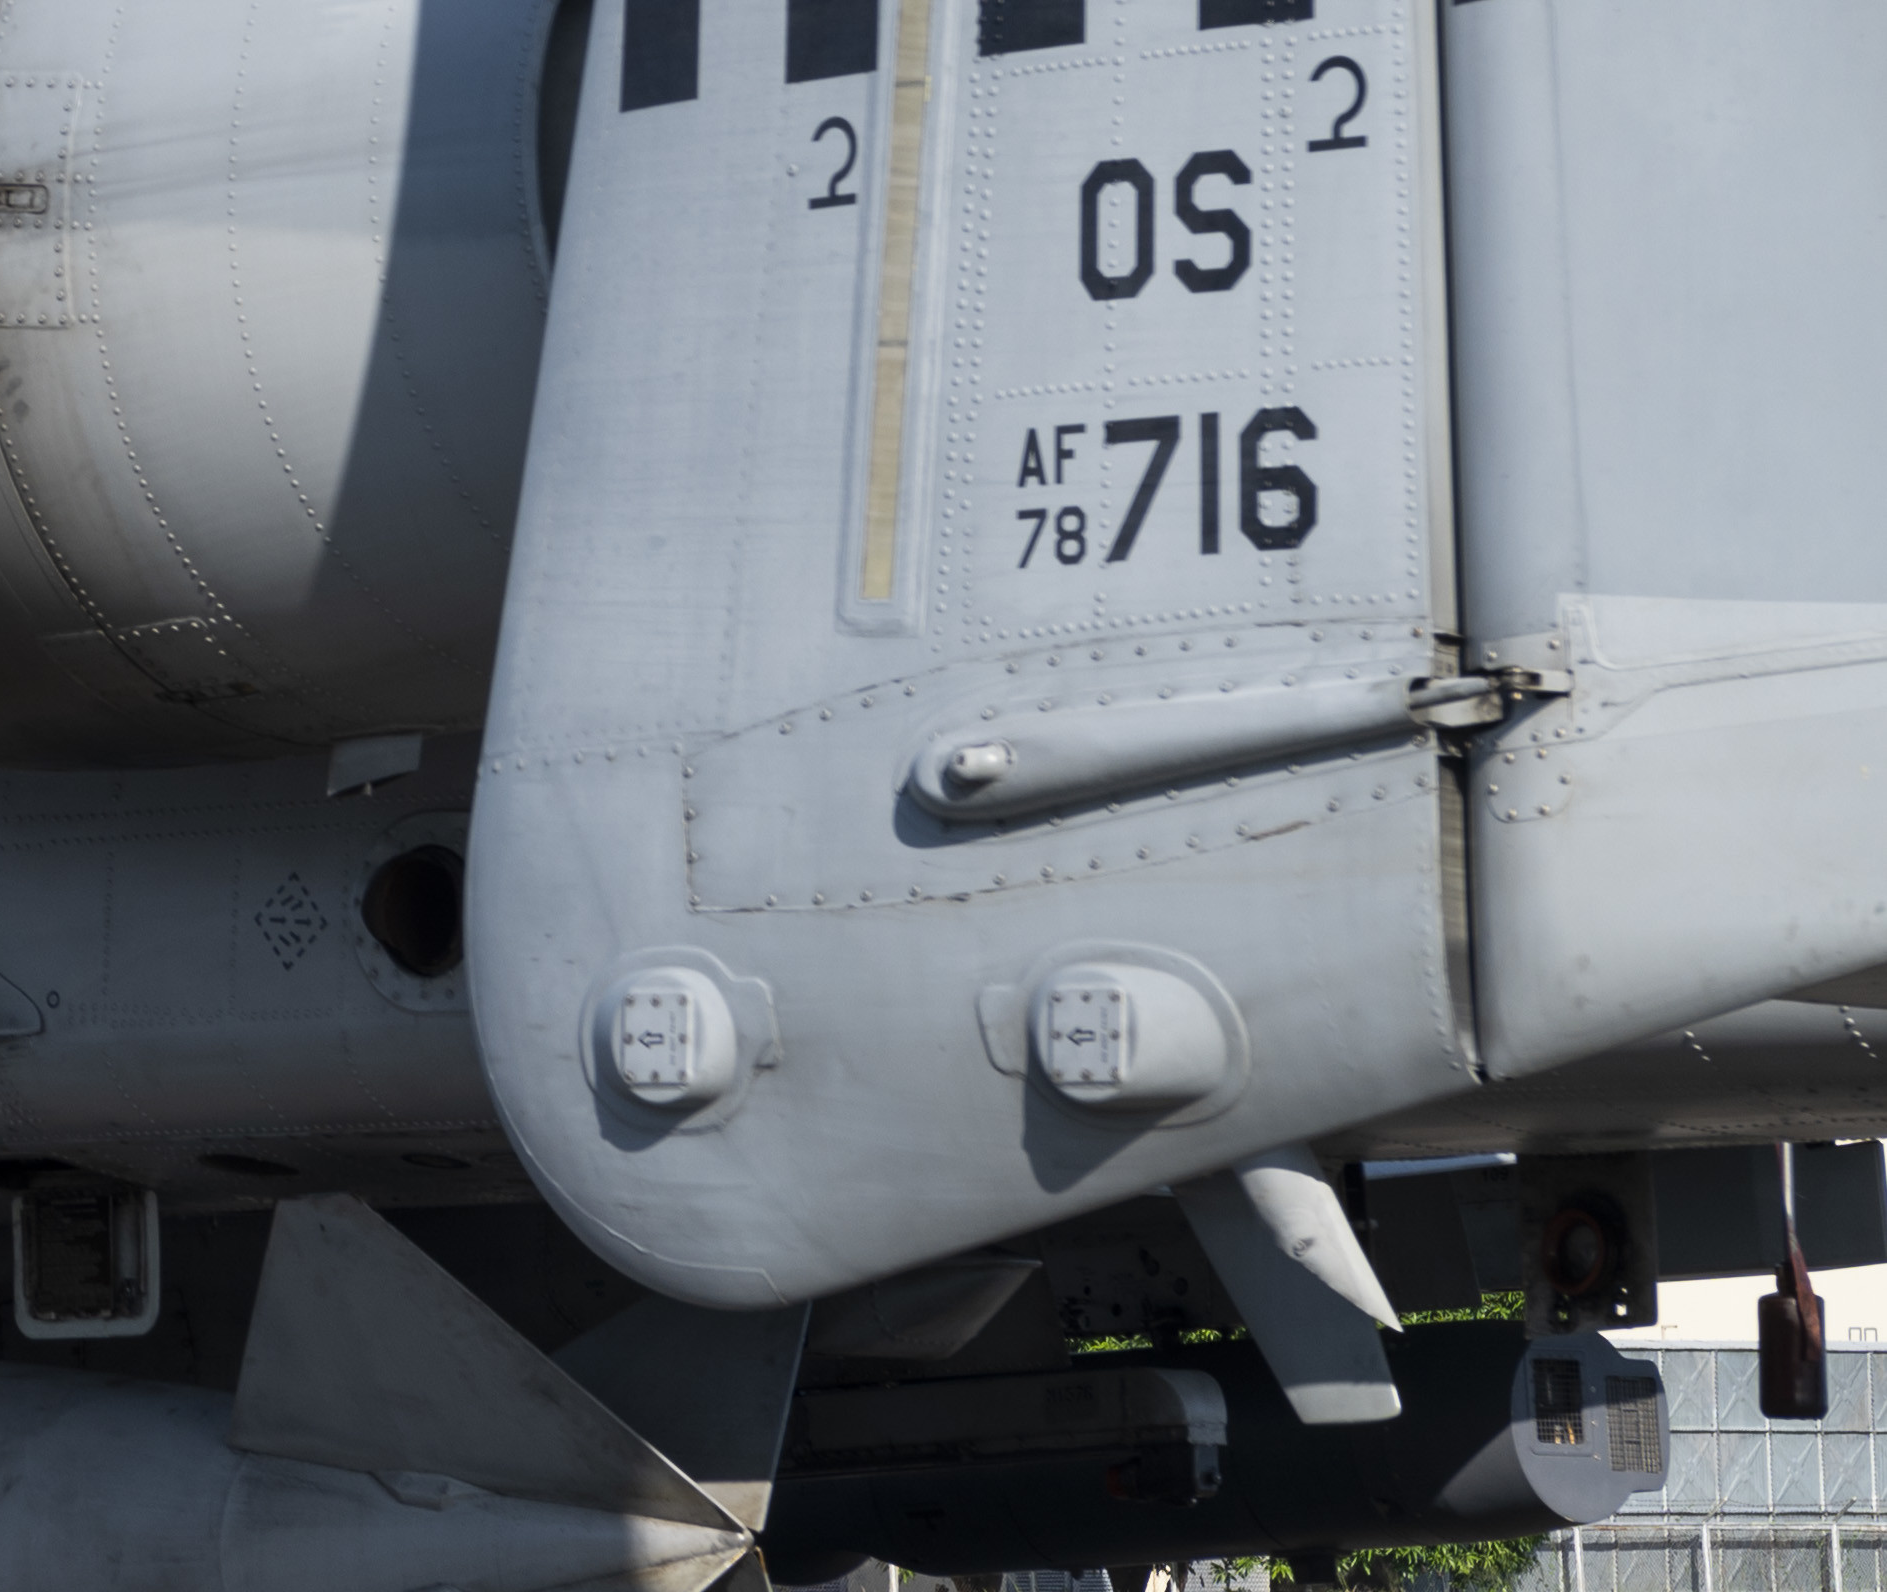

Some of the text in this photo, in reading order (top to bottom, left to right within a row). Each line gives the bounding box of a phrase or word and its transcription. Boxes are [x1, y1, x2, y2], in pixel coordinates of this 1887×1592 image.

[1307, 55, 1367, 153] 2
[808, 116, 858, 210] 2
[1080, 149, 1251, 301] OS
[1018, 423, 1086, 488] AF
[1104, 406, 1317, 563] 716
[1017, 507, 1087, 569] 78
